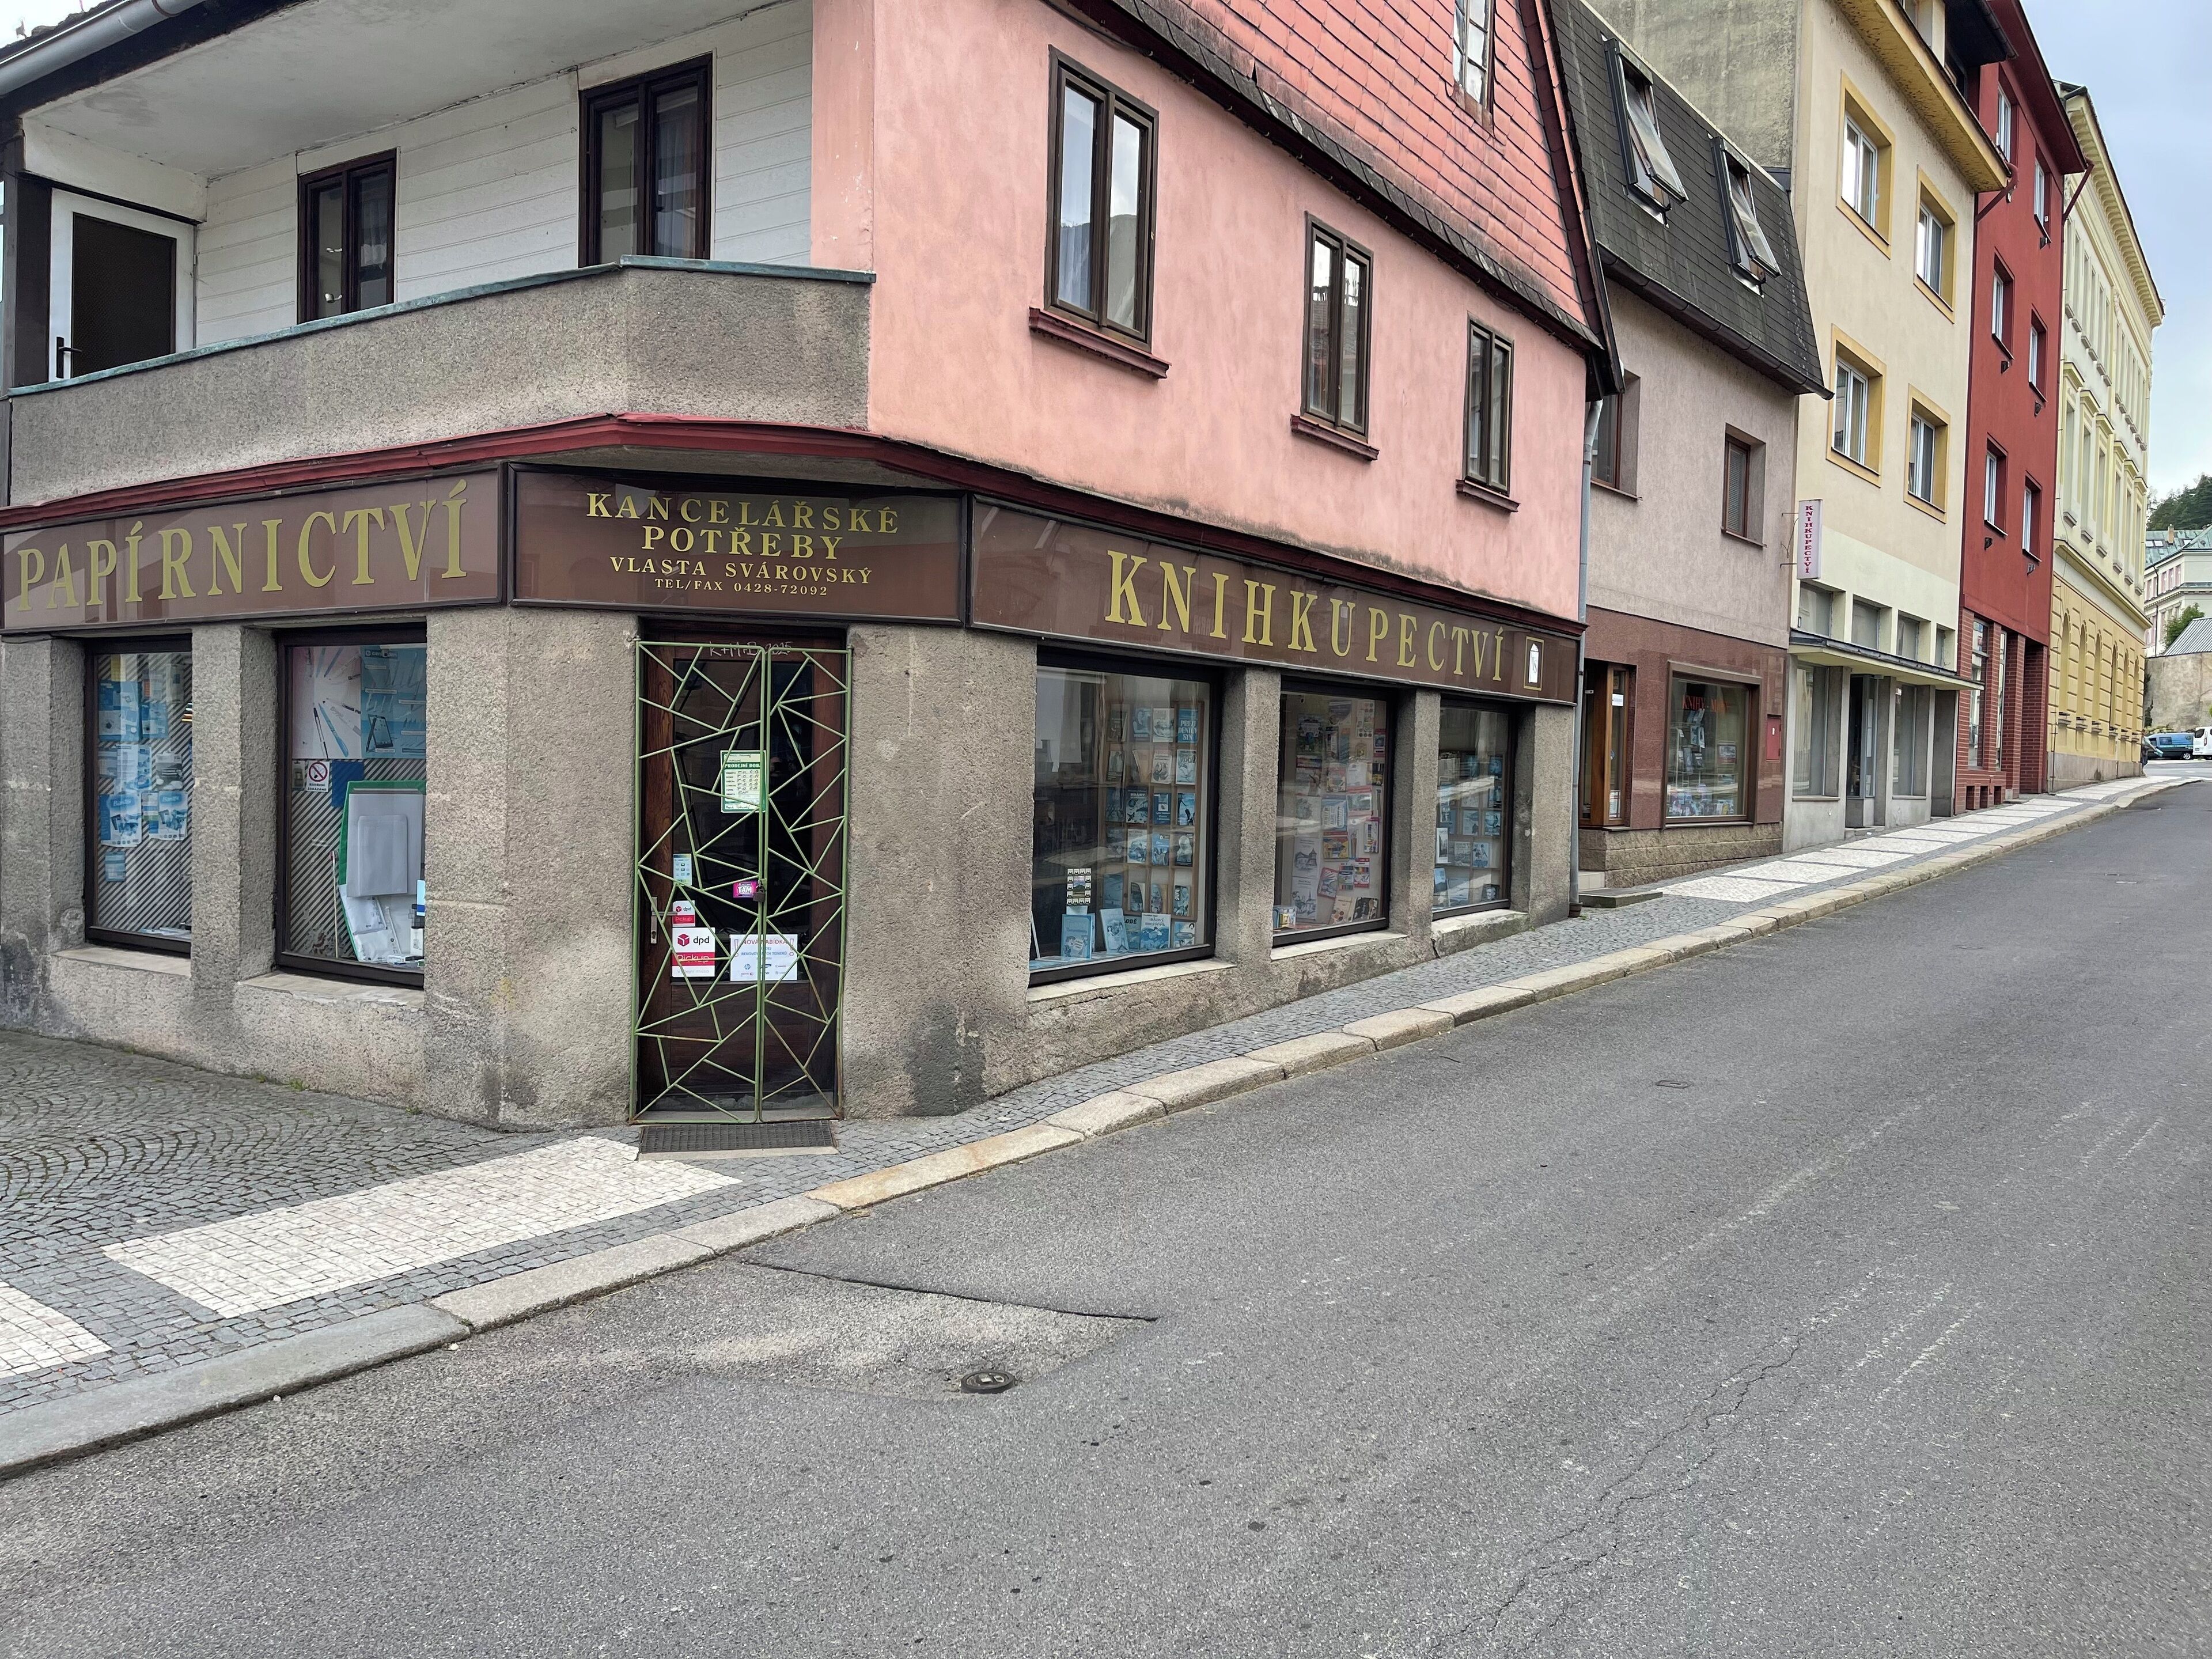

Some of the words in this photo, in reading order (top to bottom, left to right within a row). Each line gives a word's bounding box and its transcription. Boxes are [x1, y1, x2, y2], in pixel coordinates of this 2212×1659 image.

[586, 493, 899, 534] KANCELÁŘSKÉ
[17, 479, 468, 612] PAPÍRNICTVÍ
[641, 525, 843, 560] POTŘEBY
[1804, 505, 1813, 573] KNIHKUPECTVÍ
[609, 556, 707, 576] VLASTA
[724, 562, 872, 584] SVÁROVSKÝ
[654, 578, 724, 592] TEL/FAX
[733, 583, 828, 596] 0428-72092
[1105, 550, 1503, 682] KNIHKUPECTVÍ
[693, 936, 710, 945] dpd
[677, 954, 710, 964] Pickup
